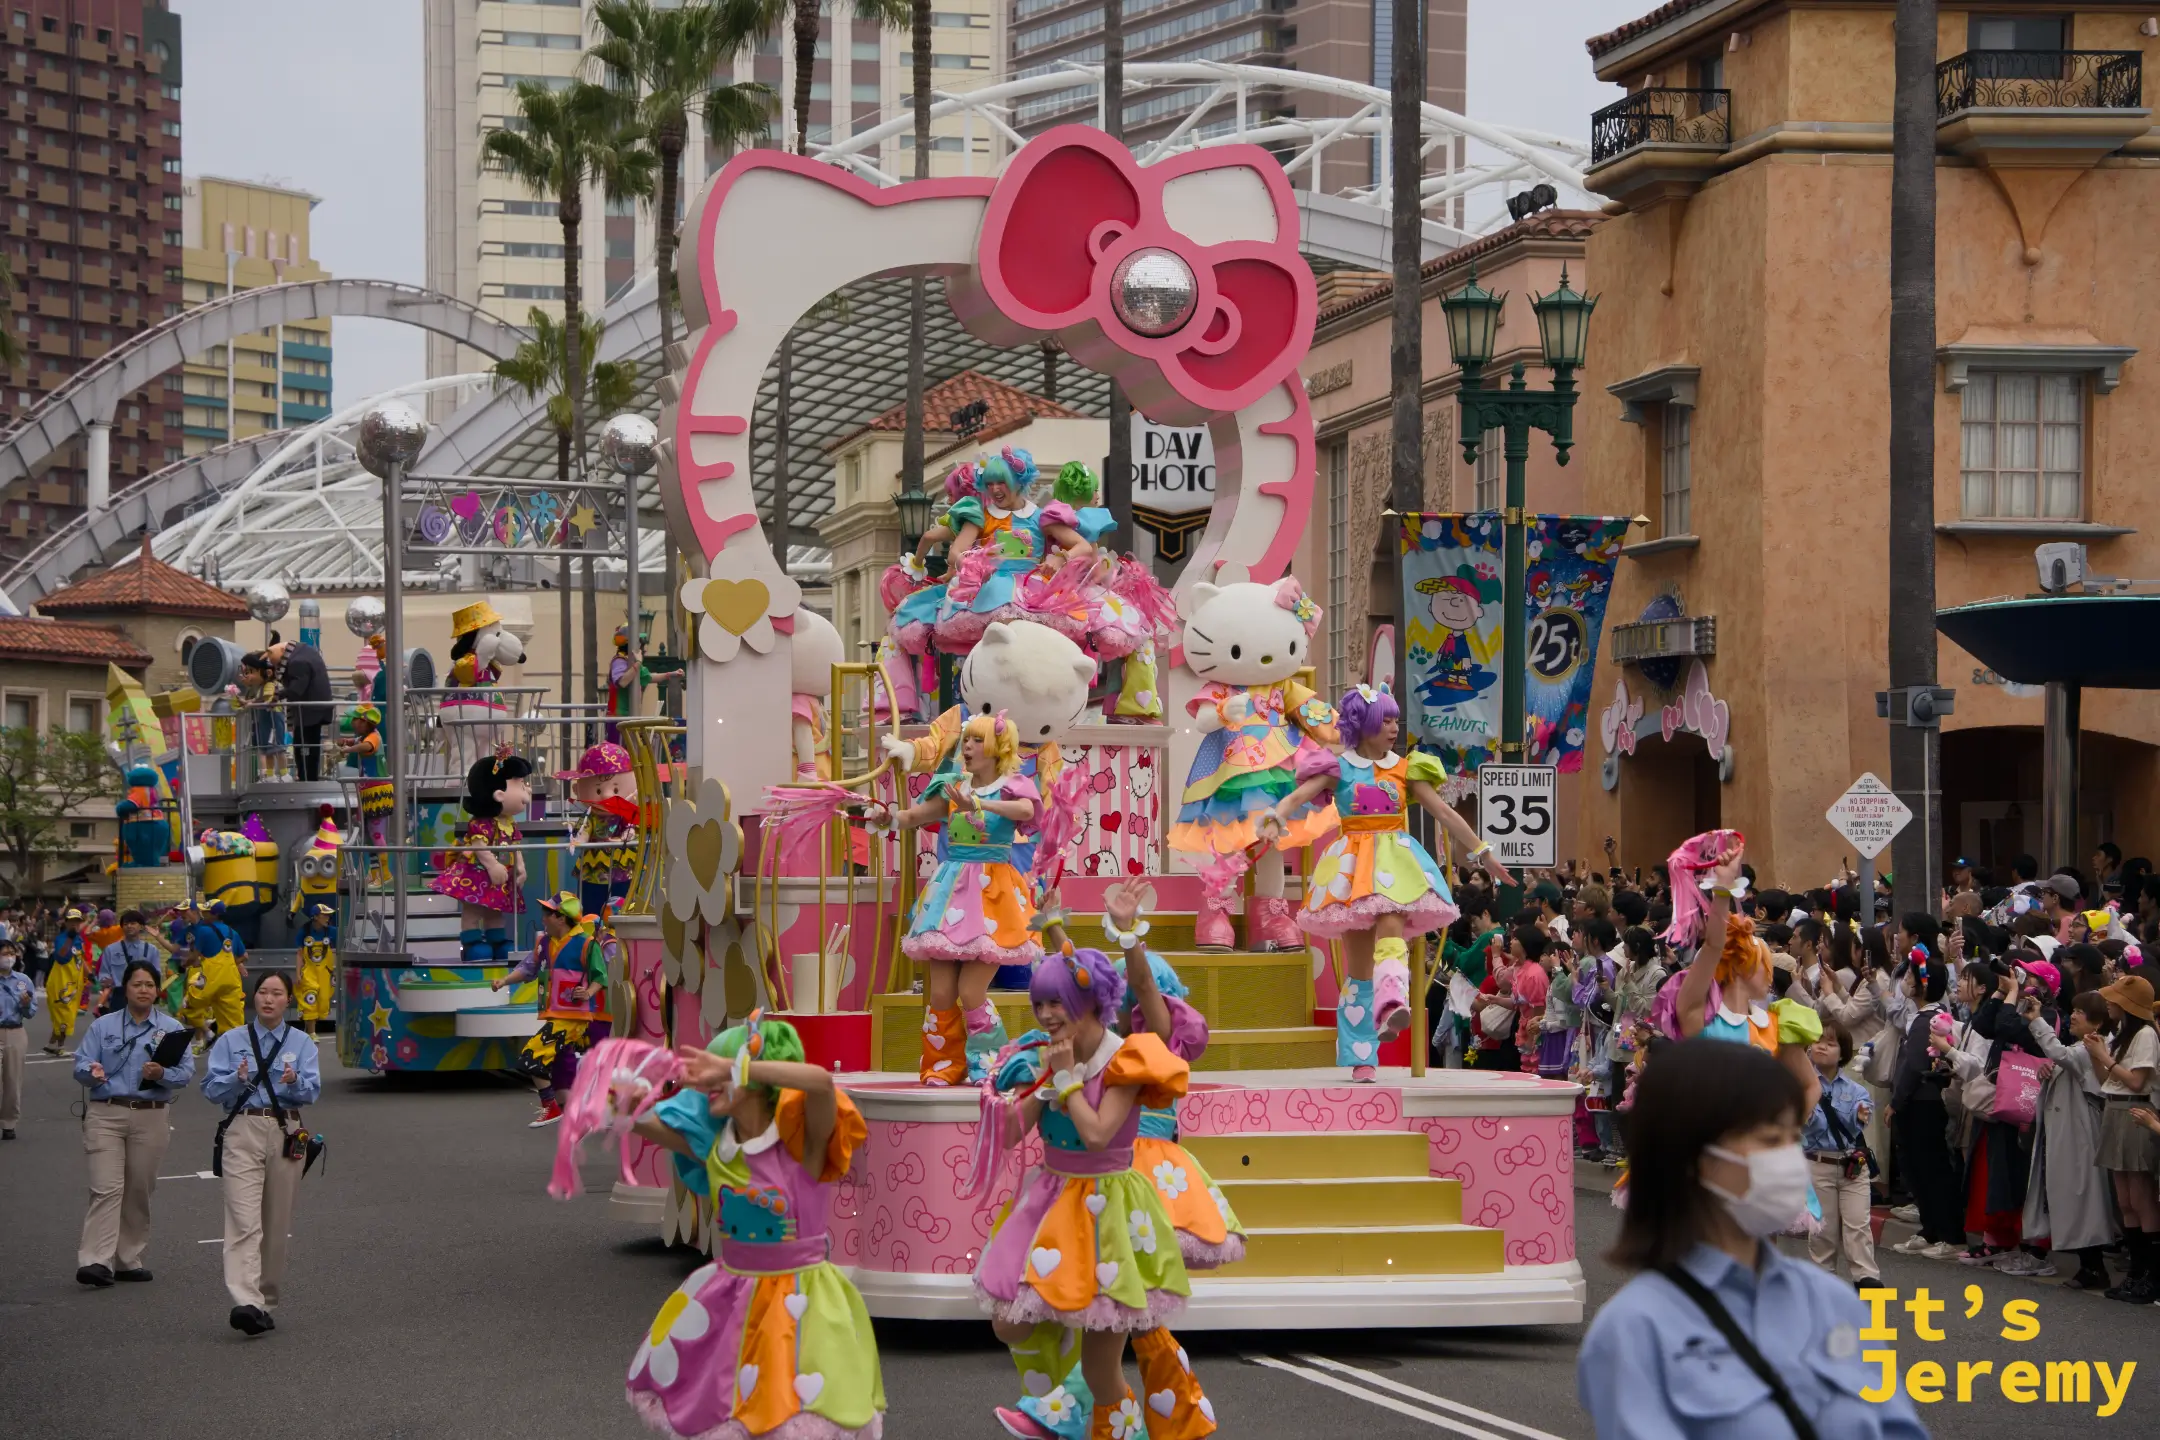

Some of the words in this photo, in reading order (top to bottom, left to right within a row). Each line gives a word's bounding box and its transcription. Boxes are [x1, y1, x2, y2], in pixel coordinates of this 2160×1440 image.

[1145, 431, 1203, 460] DAY
[1420, 714, 1489, 735] PEANUTS
[1483, 771, 1518, 787] SPEED
[1521, 772, 1553, 787] LIMIT
[1849, 797, 1858, 805] NO
[1859, 797, 1889, 805] STOPPING
[1486, 794, 1551, 836] 35
[1500, 842, 1535, 857] MILES
